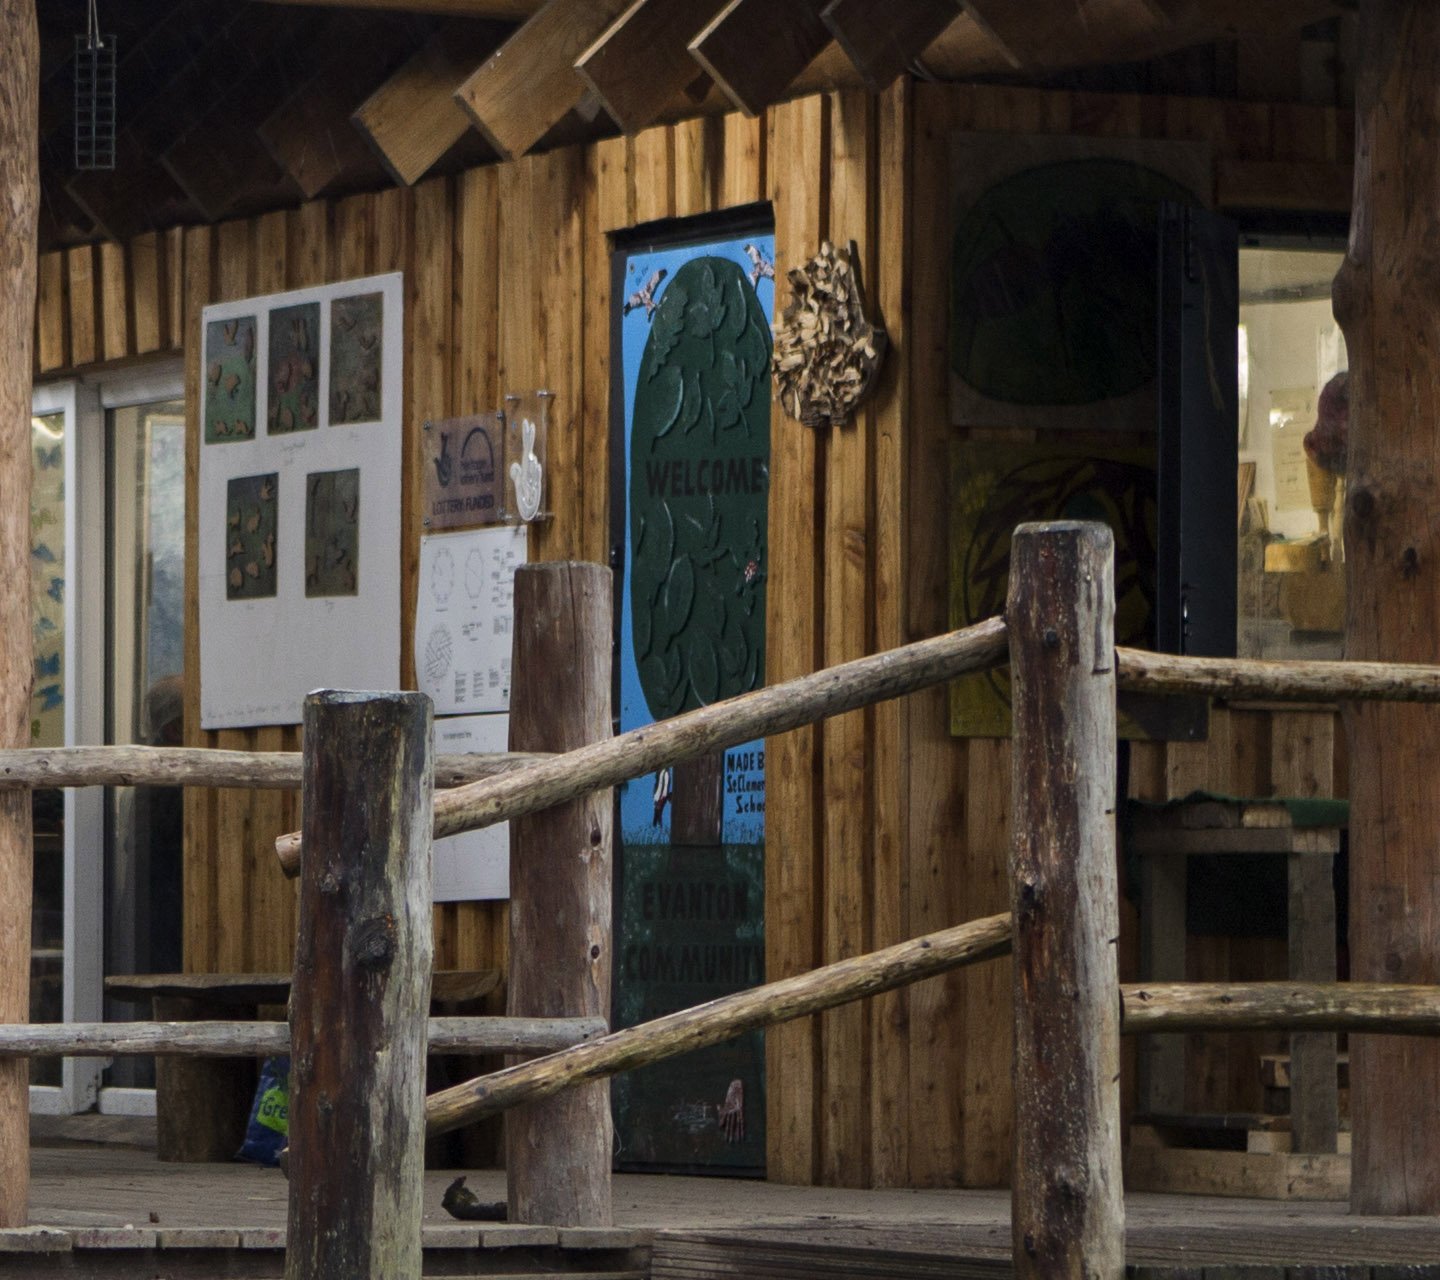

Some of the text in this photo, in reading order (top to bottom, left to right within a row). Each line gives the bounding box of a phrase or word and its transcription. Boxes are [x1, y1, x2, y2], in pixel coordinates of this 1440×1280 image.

[645, 456, 763, 498] WELCOME
[432, 498, 464, 516] LOTTERY
[727, 752, 754, 773] MADE
[643, 882, 749, 921] EVANTON
[626, 943, 766, 983] COMMUNITY
